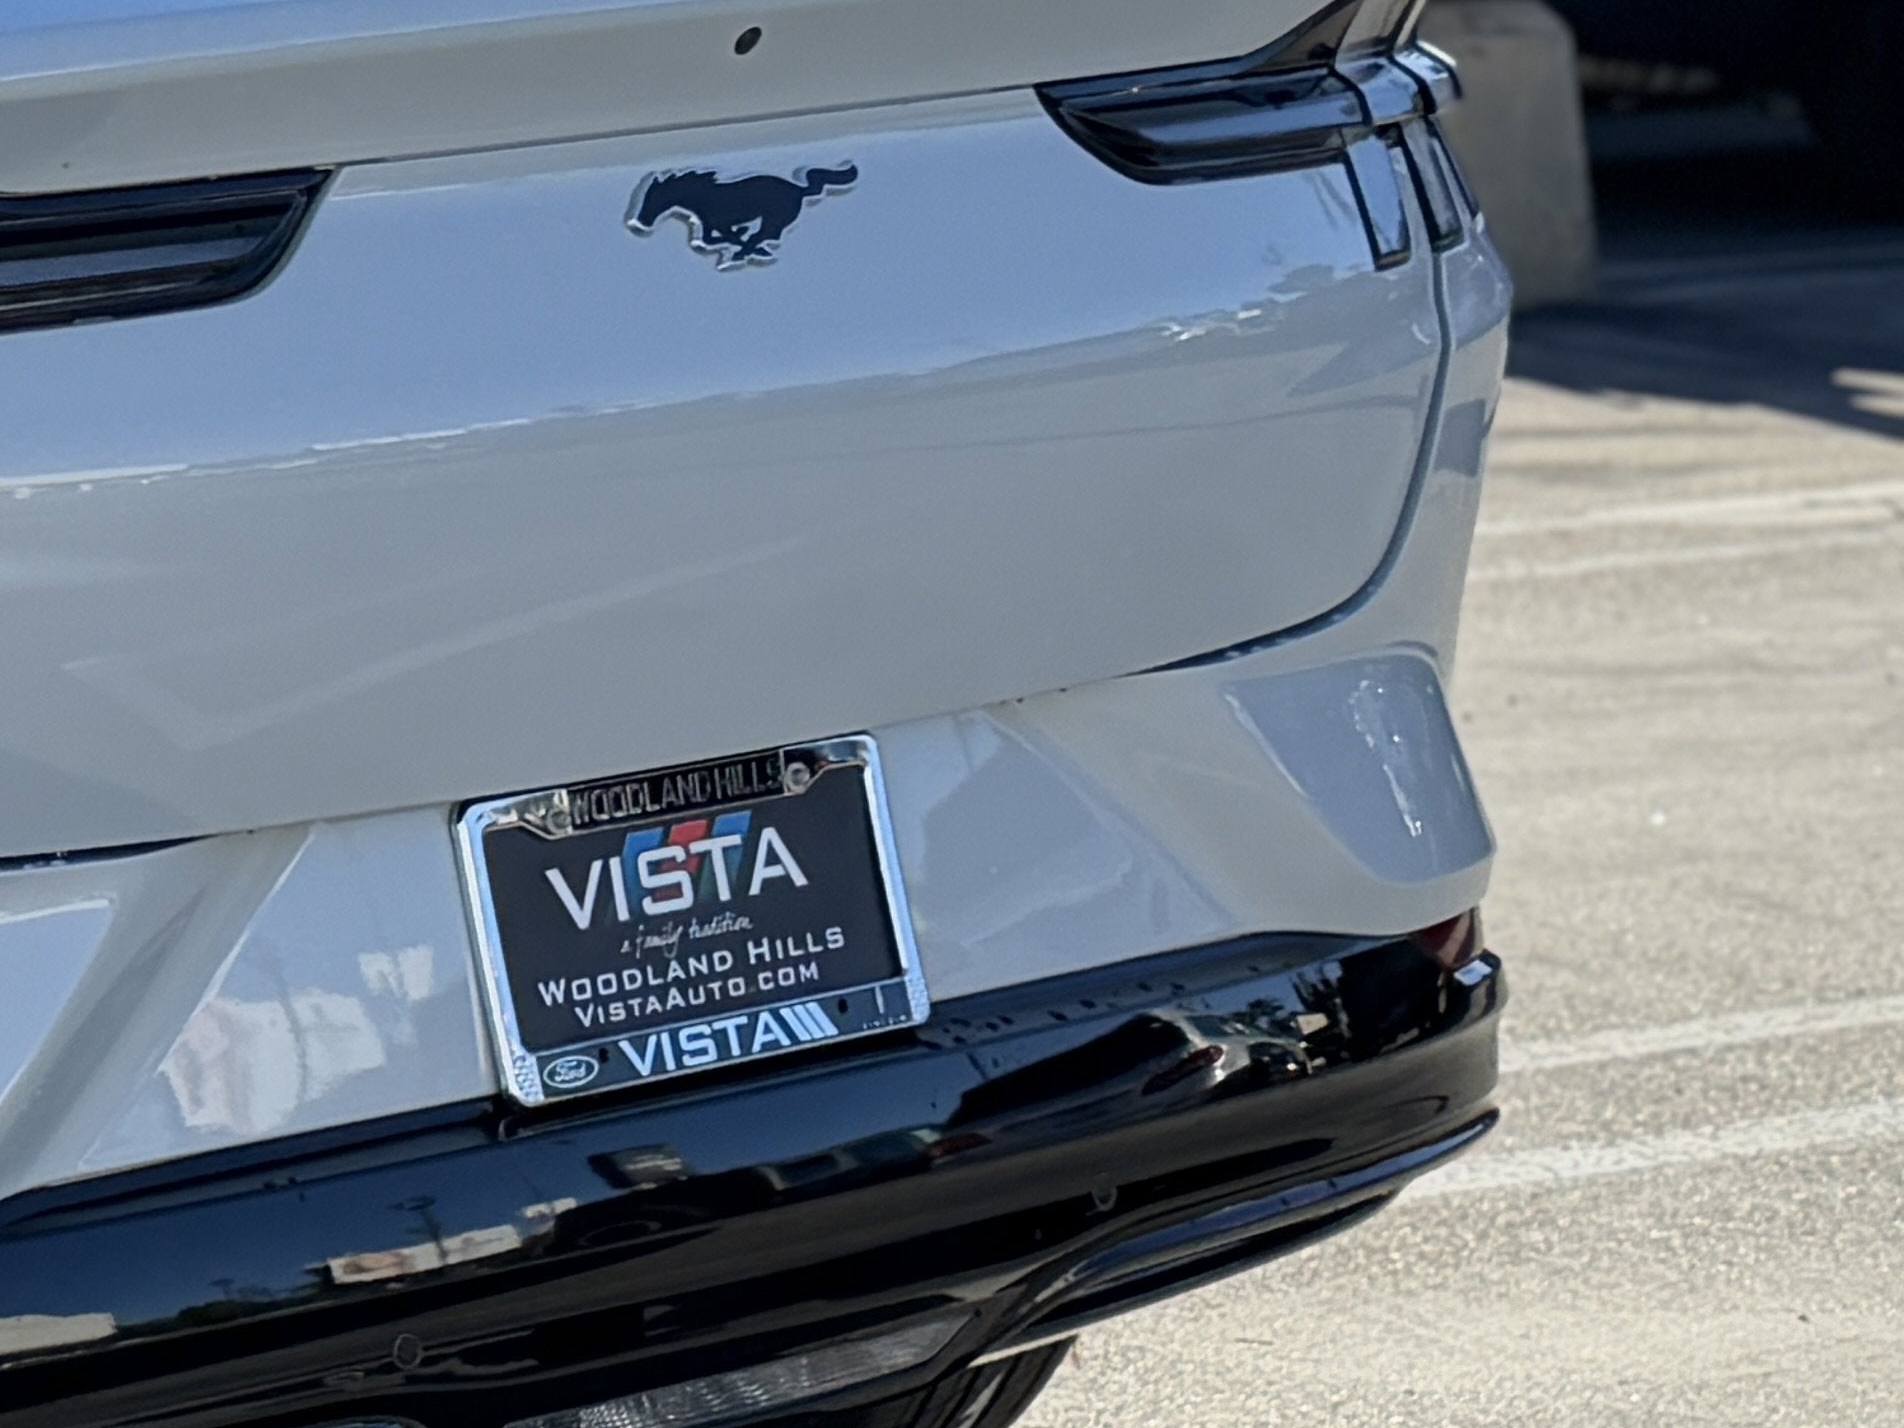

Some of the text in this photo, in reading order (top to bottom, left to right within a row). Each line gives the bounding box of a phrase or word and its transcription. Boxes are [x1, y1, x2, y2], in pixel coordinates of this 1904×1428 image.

[570, 770, 711, 825] WOODLAND
[544, 826, 809, 930] VISTA
[537, 926, 845, 1007] WOODLAND HILLS
[617, 1010, 792, 1076] VISTA
